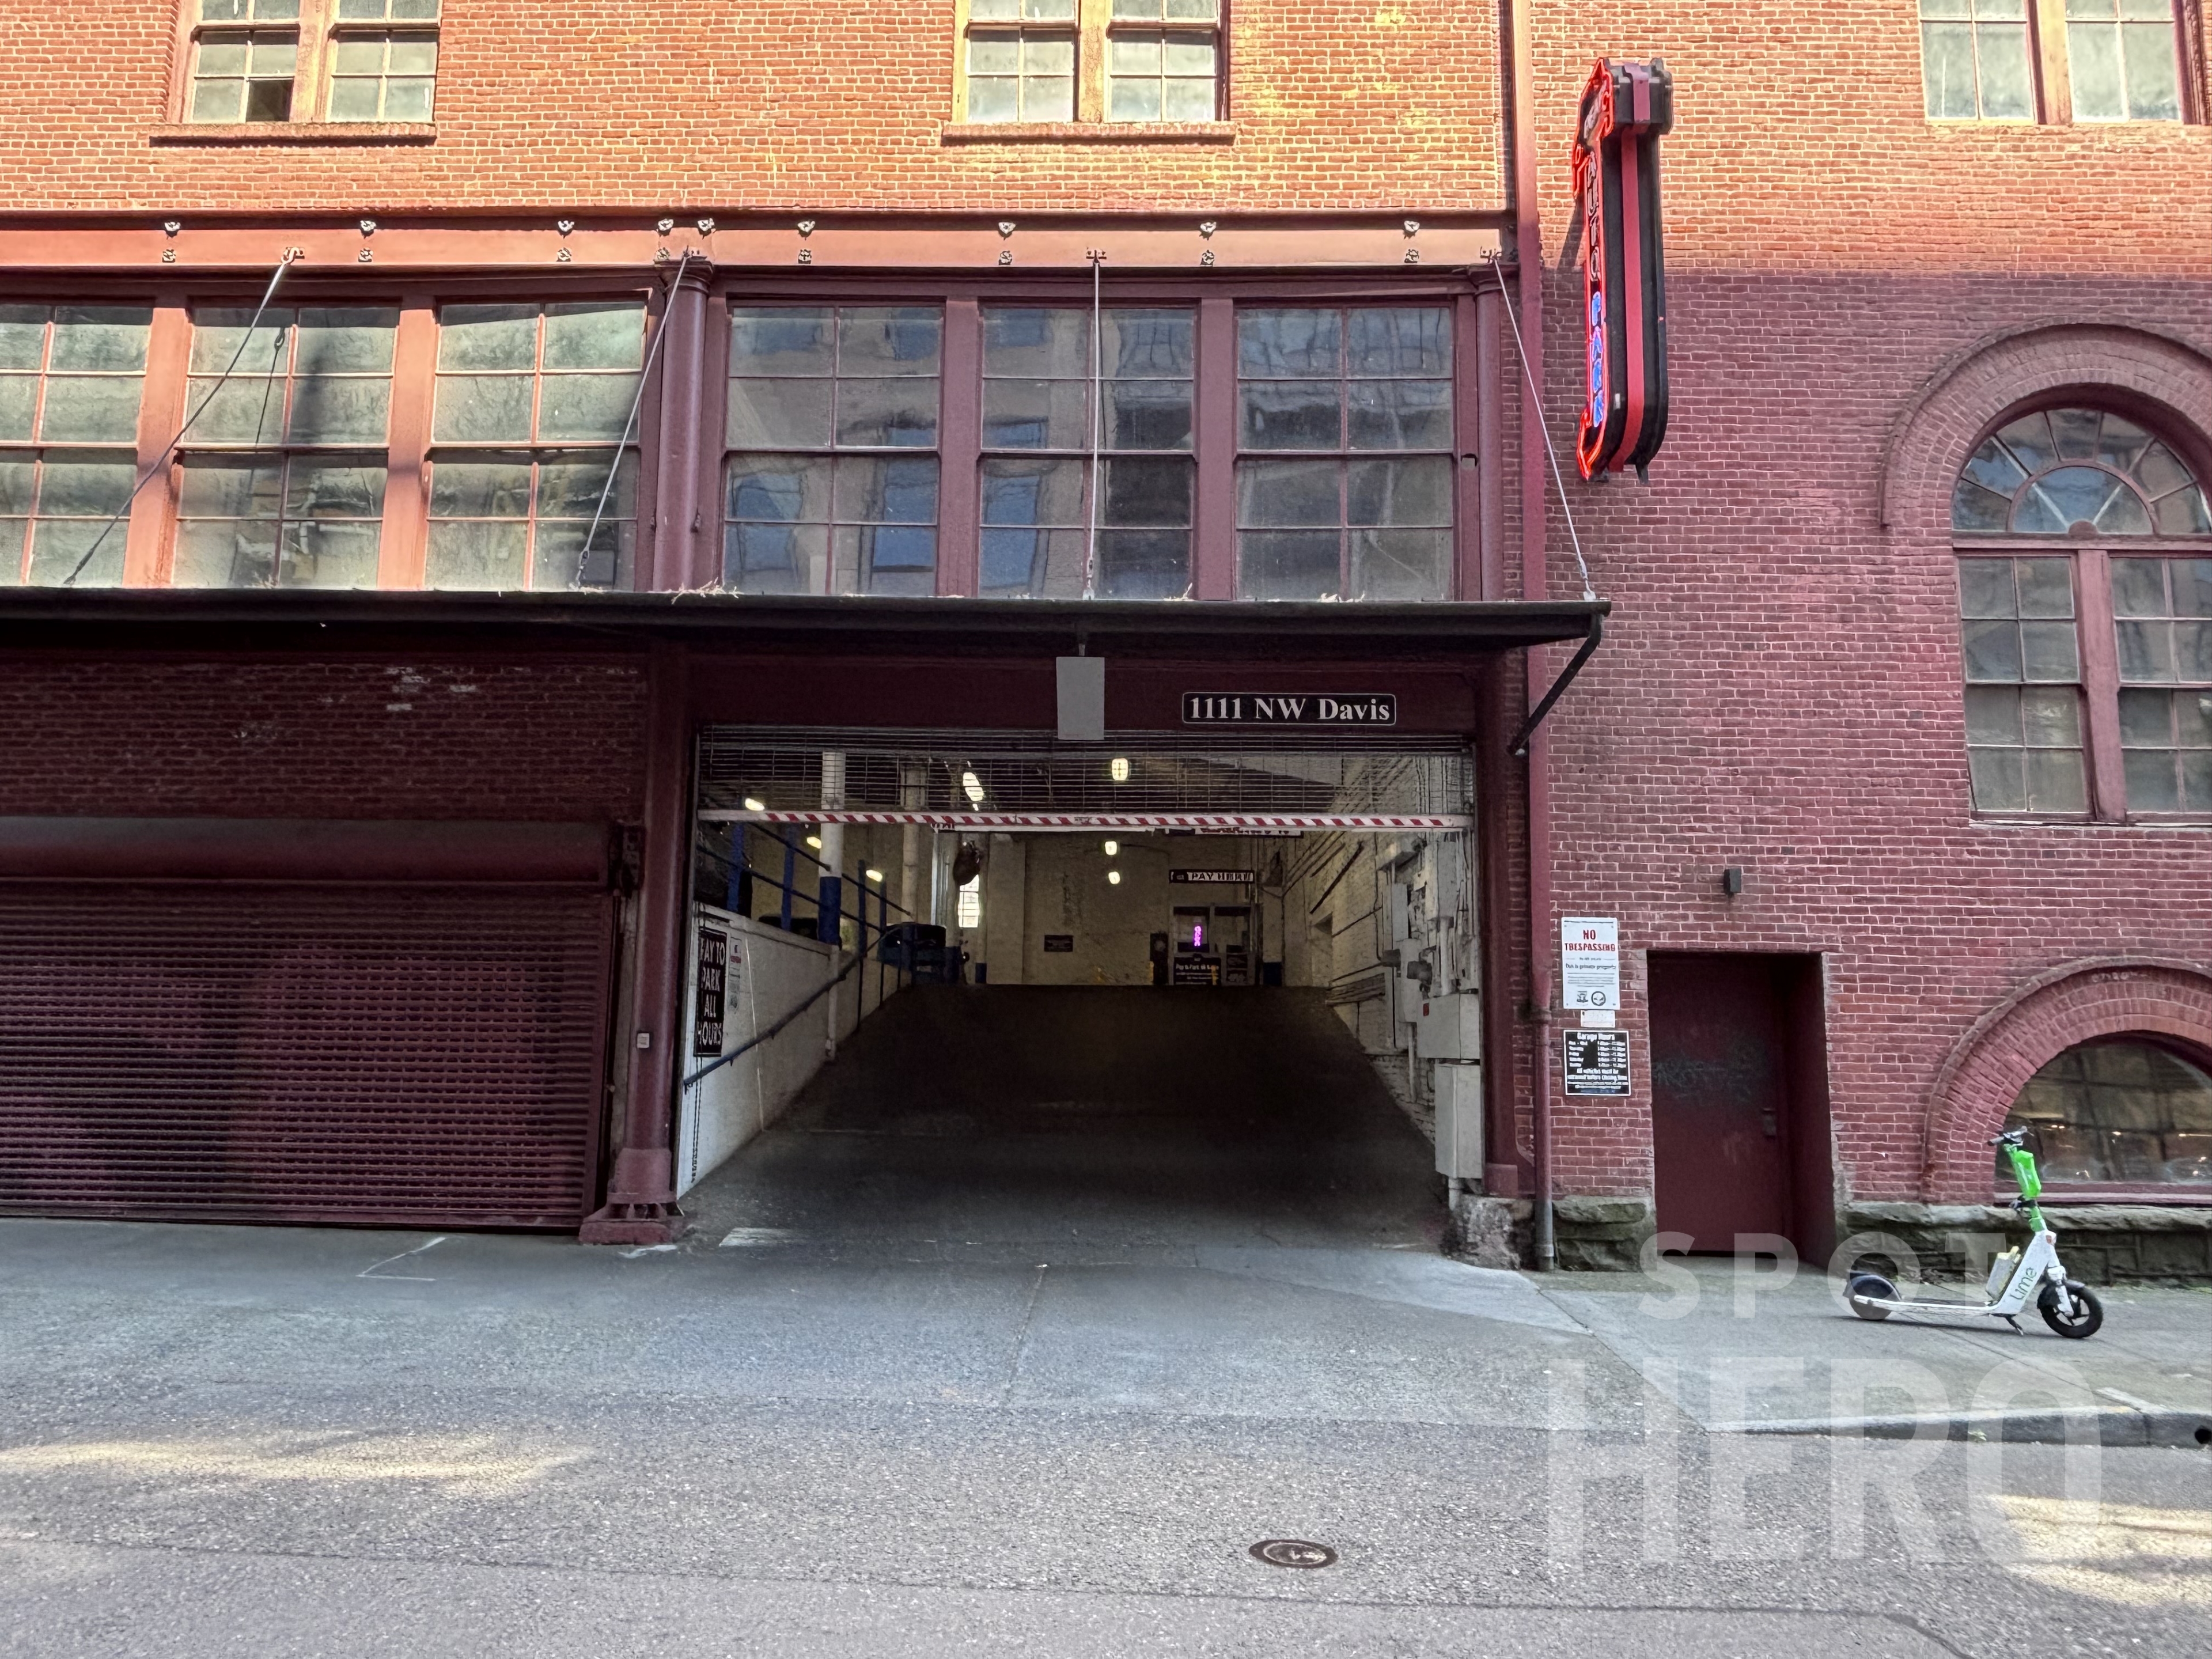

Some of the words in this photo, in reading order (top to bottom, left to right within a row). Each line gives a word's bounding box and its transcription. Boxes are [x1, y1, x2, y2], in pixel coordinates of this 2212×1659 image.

[1190, 697, 1242, 719] 1111
[1254, 698, 1306, 719] NW
[1317, 698, 1390, 720] Davis
[1191, 872, 1213, 881] PAY
[1582, 929, 1596, 940] NO
[704, 994, 717, 1018] ALL
